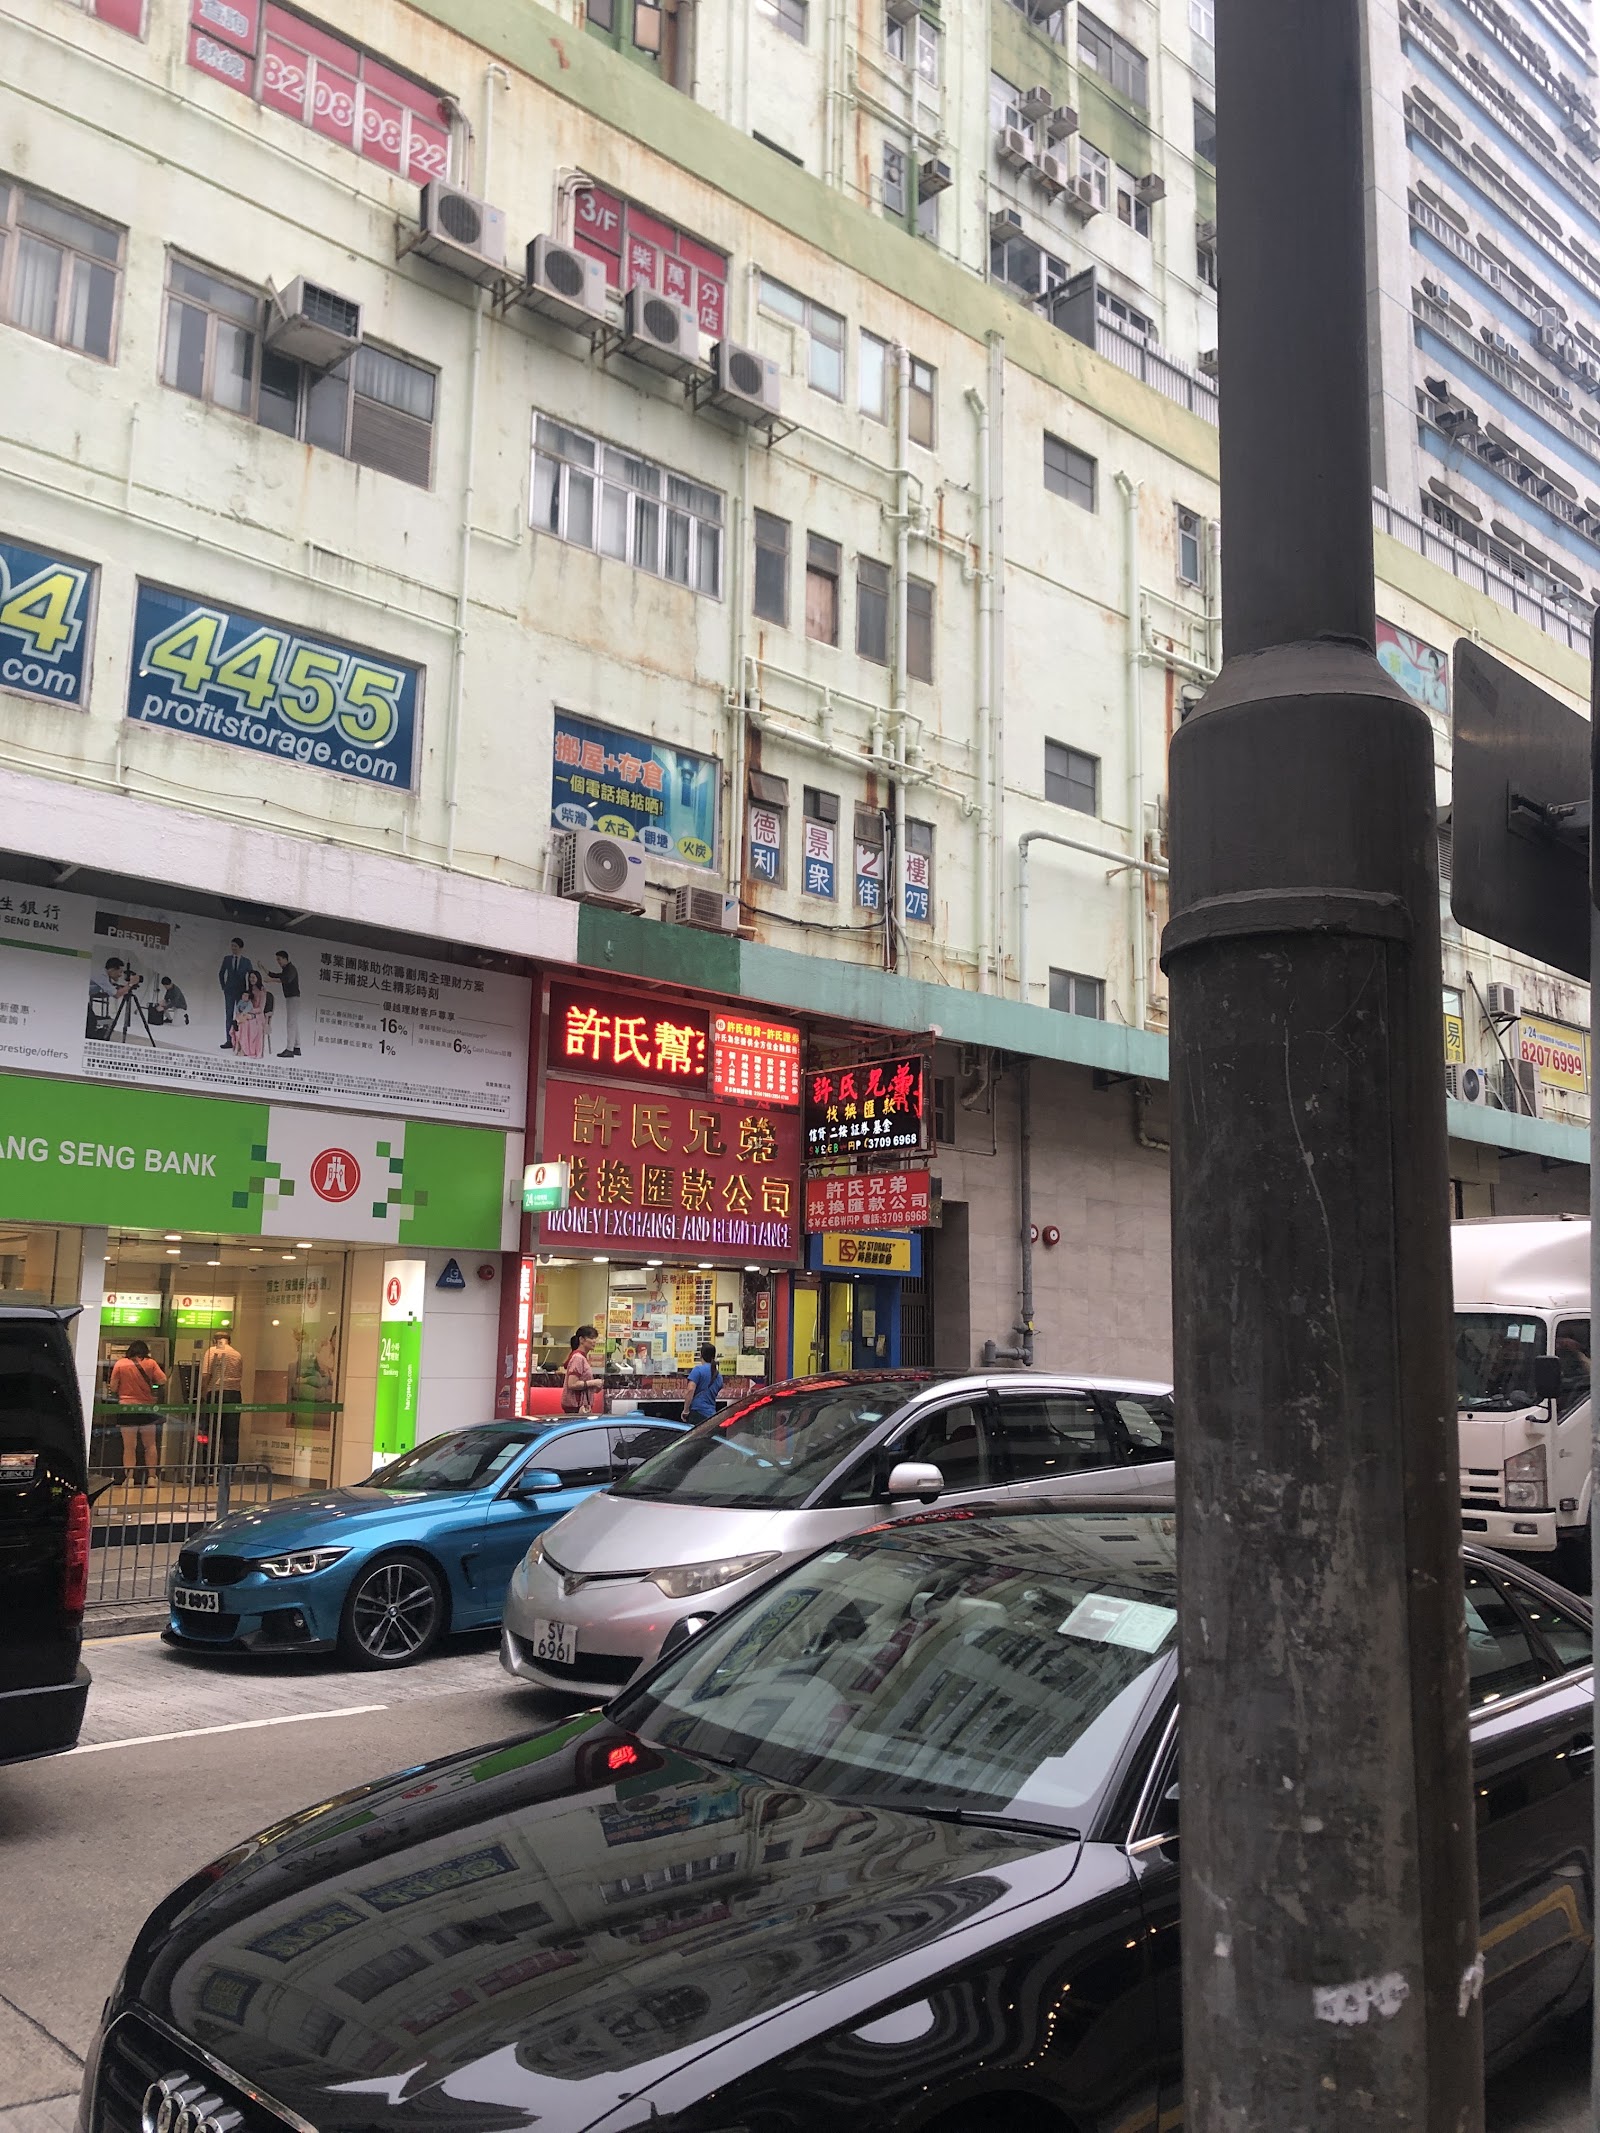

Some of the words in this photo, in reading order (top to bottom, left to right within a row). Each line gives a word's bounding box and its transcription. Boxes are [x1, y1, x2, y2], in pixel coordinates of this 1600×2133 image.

[579, 193, 618, 231] 3/F
[701, 282, 720, 331] 分店
[140, 606, 406, 750] 4455
[141, 692, 398, 782] profitstorage.com
[555, 731, 665, 793] 搬屋+存倉
[604, 819, 630, 839] 太古
[644, 829, 669, 850] 觀塘
[684, 841, 706, 859] 火炭
[4, 915, 30, 927] SENG
[33, 920, 59, 931] BANK
[108, 926, 161, 945] PRESTIGE
[379, 1017, 408, 1036] 16%
[1447, 1021, 1460, 1048] 易
[378, 1039, 396, 1056] 1%
[453, 1038, 472, 1055] 6%
[1521, 1040, 1582, 1077] 82076999
[893, 1133, 917, 1146] 6968
[58, 1140, 136, 1170] SENG
[144, 1149, 217, 1177] BANK
[826, 1175, 908, 1200] 許氏兄弟
[808, 1192, 928, 1217] 找換匯款公司
[905, 1210, 928, 1222] 6968
[682, 1214, 711, 1241] AND
[380, 1337, 391, 1361] 24
[404, 1363, 413, 1411] hangseng.com
[547, 1622, 565, 1642] SV
[538, 1639, 571, 1662] 6961
